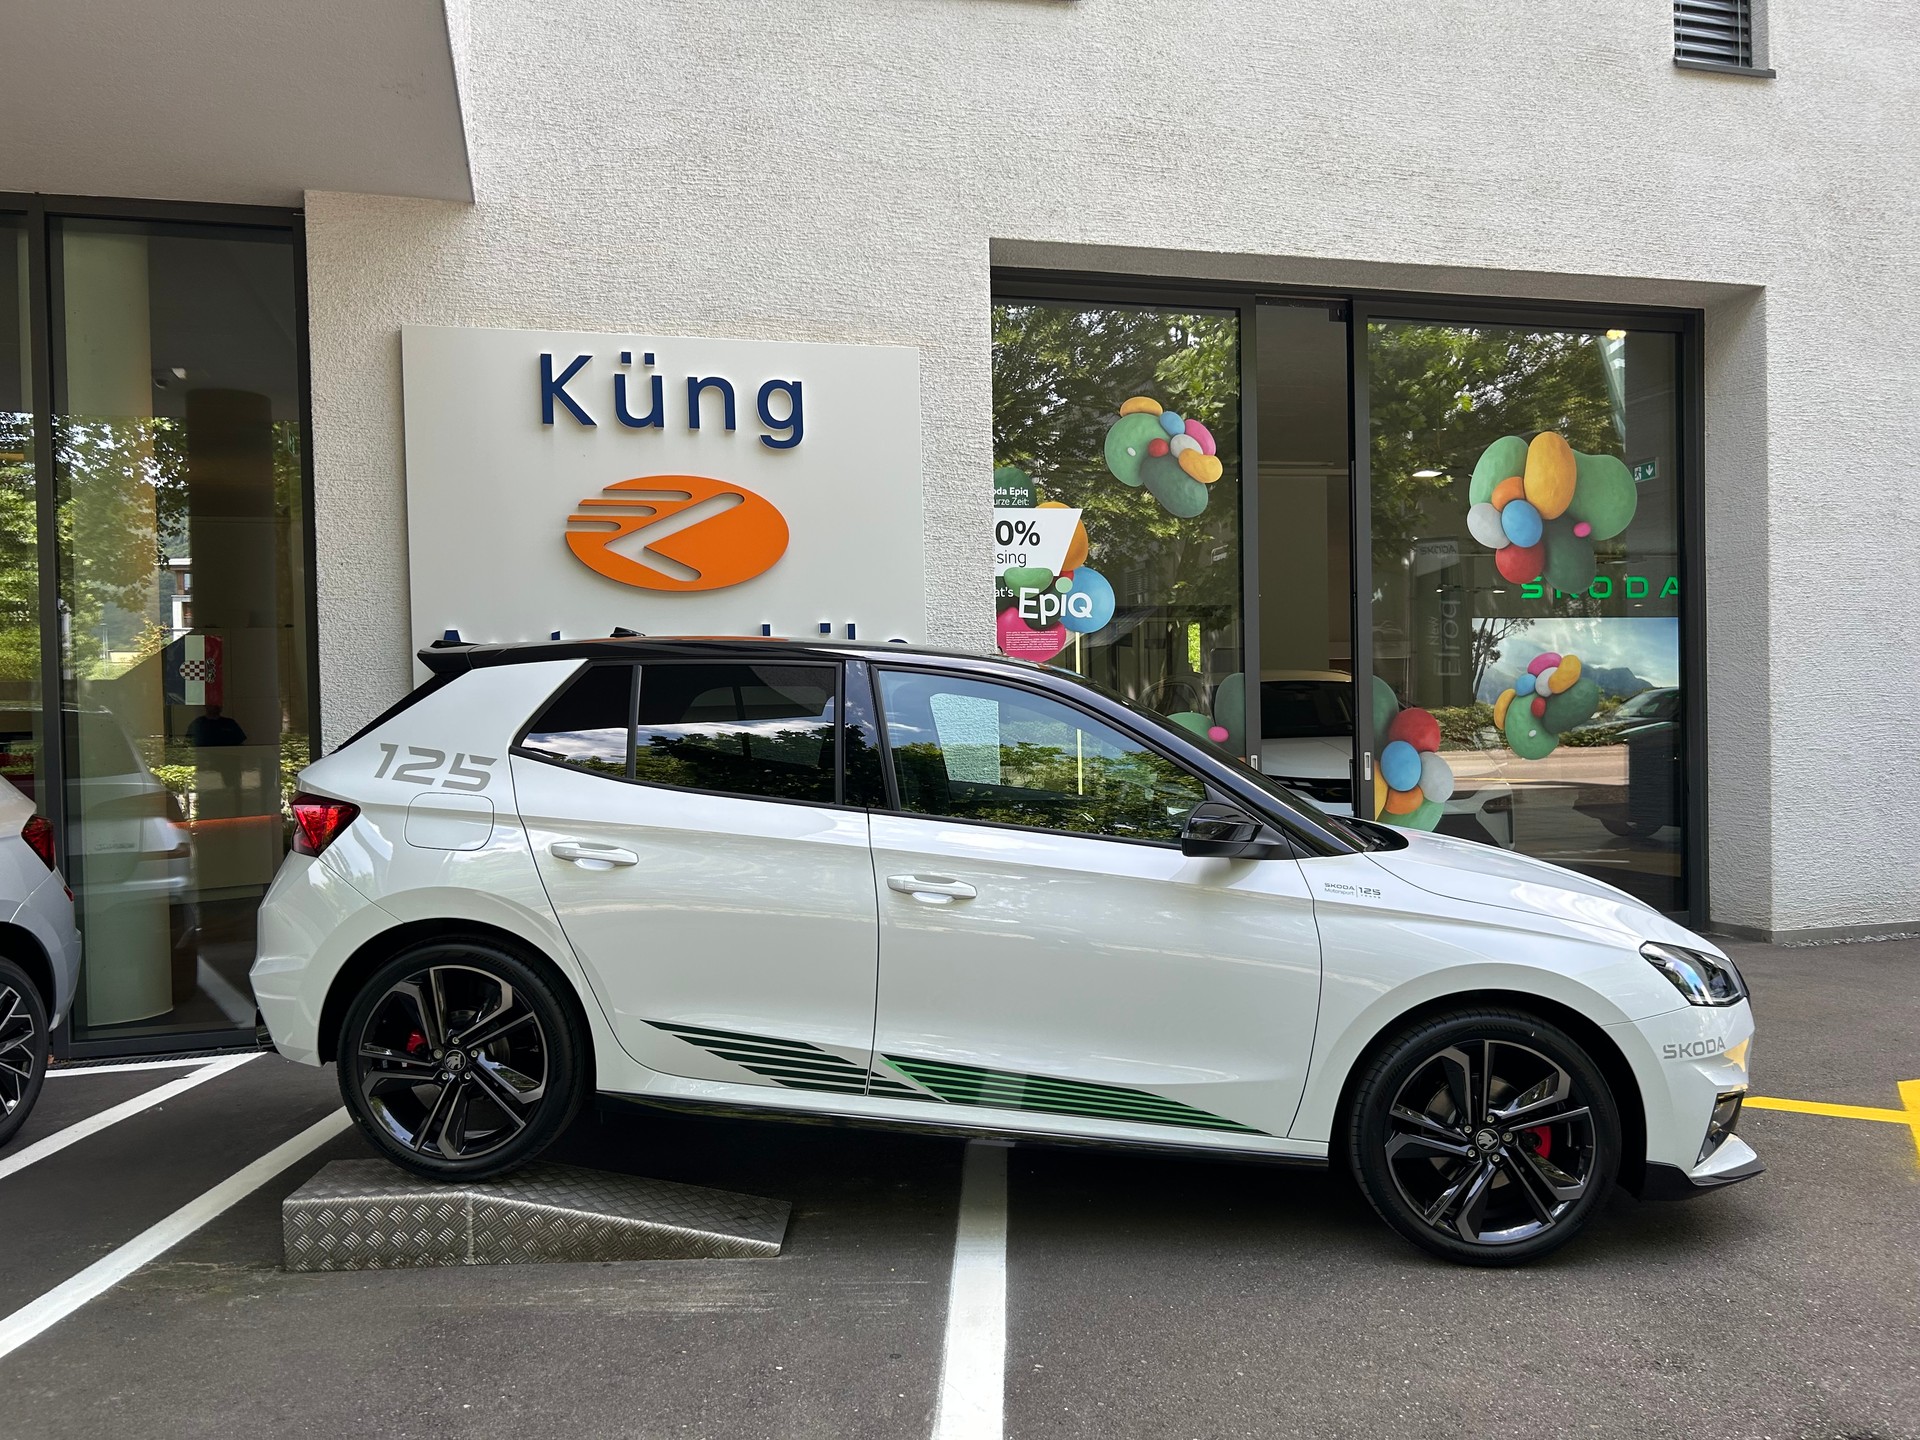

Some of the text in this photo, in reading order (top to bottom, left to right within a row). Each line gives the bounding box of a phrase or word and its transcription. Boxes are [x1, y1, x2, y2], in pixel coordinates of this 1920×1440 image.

[540, 352, 804, 449] Küng
[1009, 487, 1029, 497] Epiq
[996, 549, 1027, 568] sing
[374, 743, 498, 792] 125
